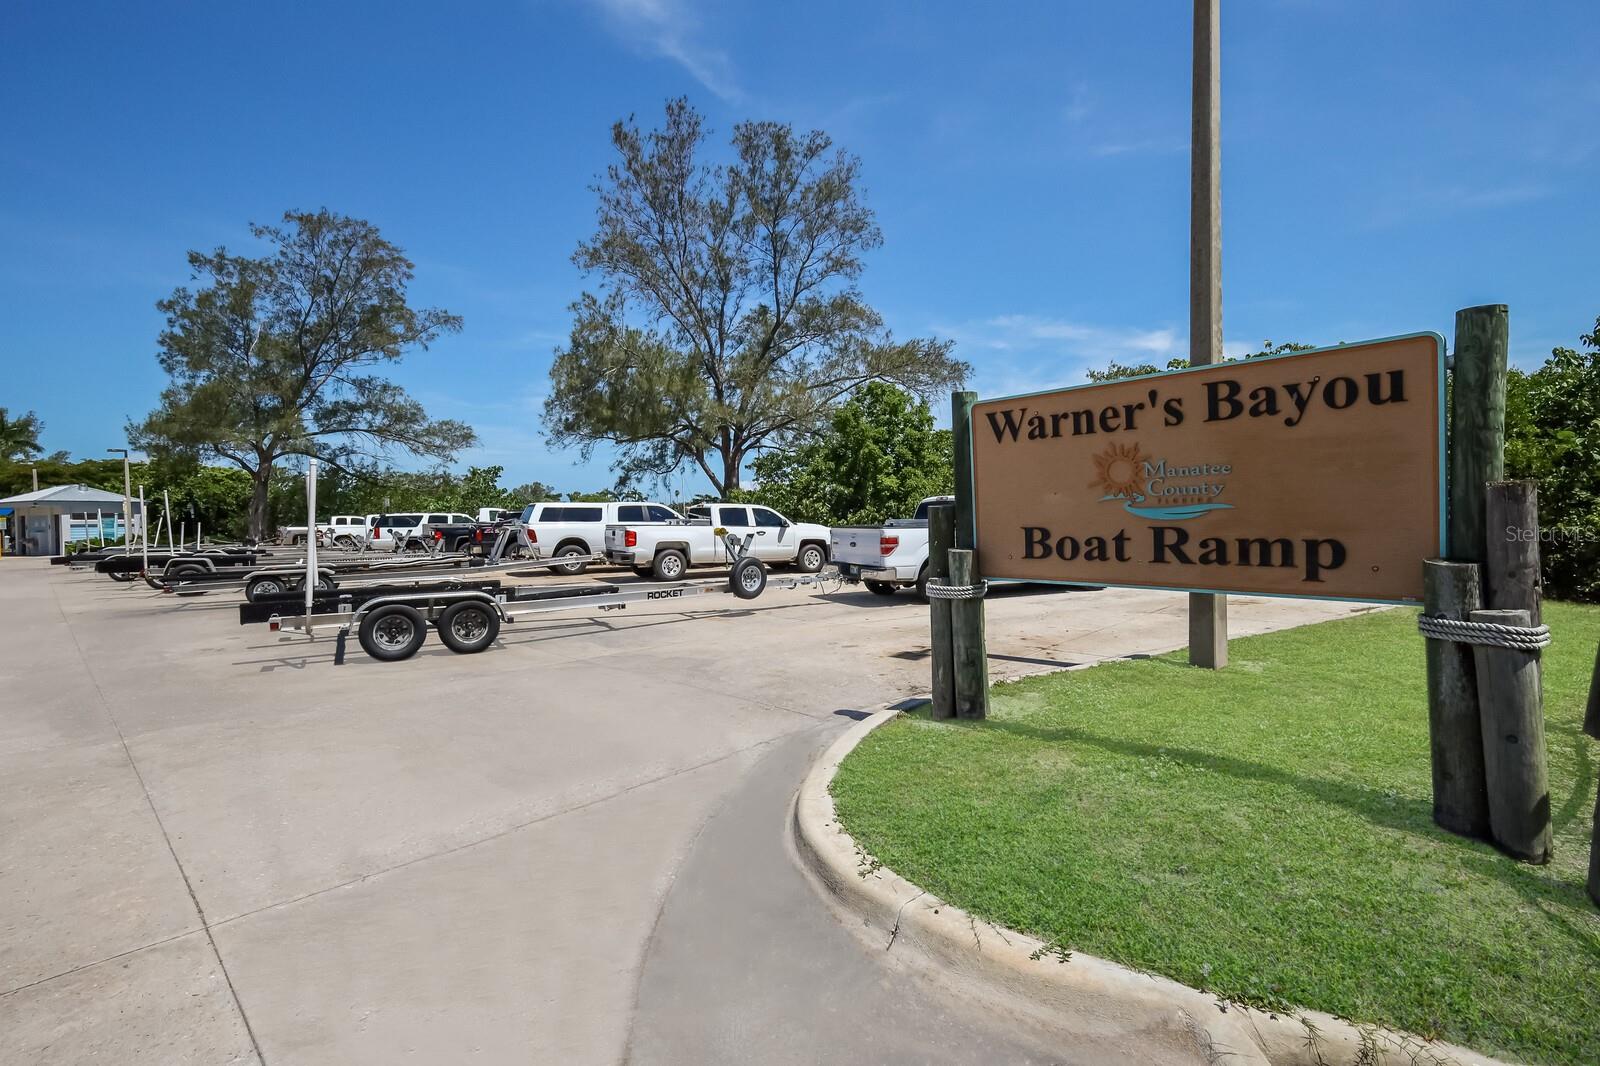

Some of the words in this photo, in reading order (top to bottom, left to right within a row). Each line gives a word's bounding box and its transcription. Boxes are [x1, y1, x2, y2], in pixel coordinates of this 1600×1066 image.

[985, 390, 1184, 444] Warner's
[1202, 369, 1408, 427] Bayou
[1143, 458, 1231, 477] Manatee
[1147, 479, 1224, 496] County
[1021, 526, 1133, 562] Boat
[1148, 526, 1347, 582] Ramp
[647, 589, 684, 600] ROCKET
